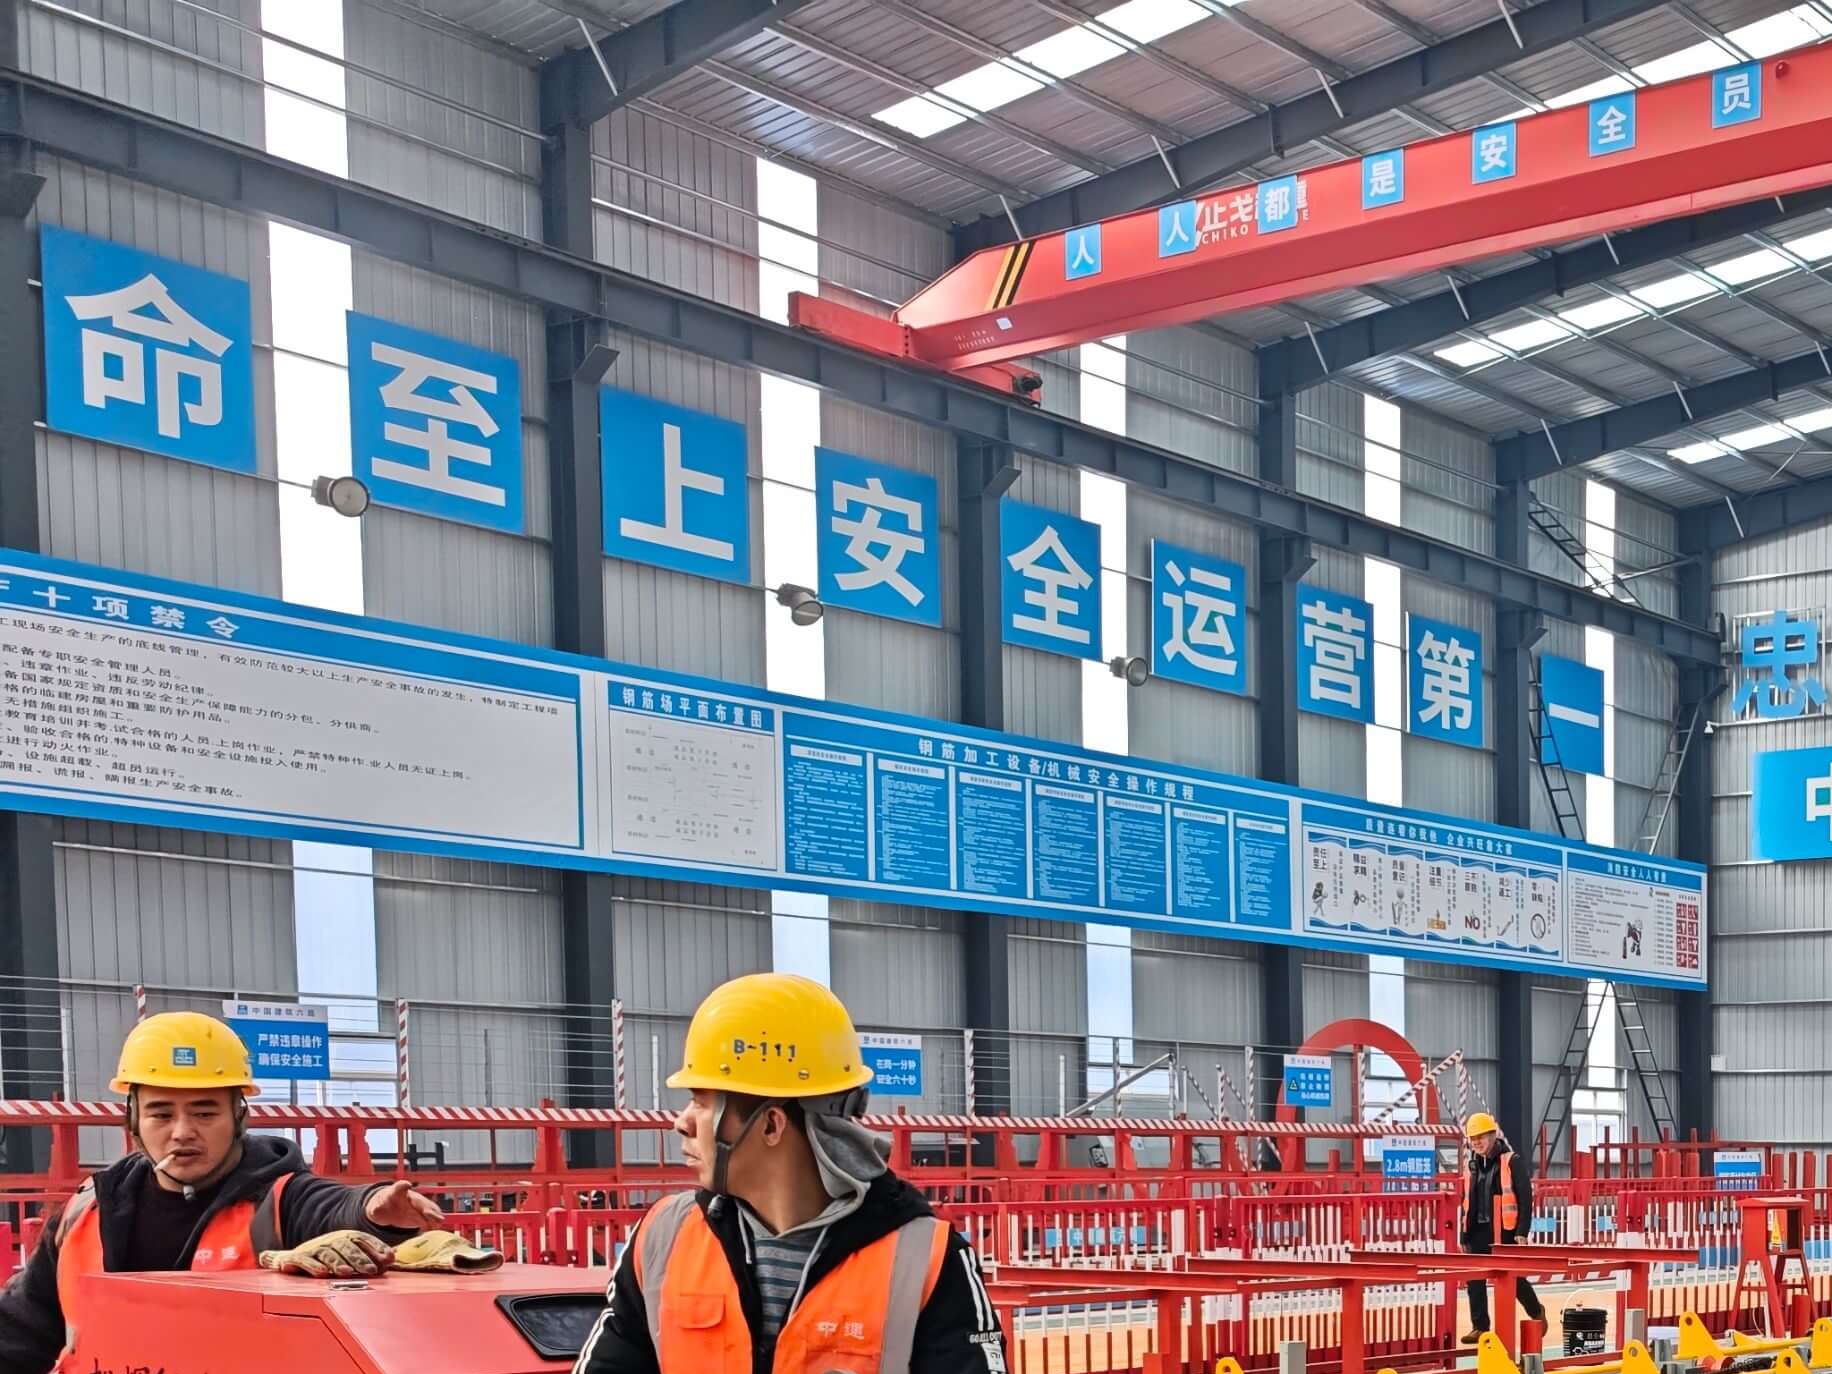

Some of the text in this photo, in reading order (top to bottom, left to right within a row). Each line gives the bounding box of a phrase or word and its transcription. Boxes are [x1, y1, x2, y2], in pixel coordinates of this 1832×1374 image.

[1072, 76, 1751, 269] 人 人 都 是 安 全 员
[1202, 225, 1249, 245] CHIKO
[65, 274, 1601, 731] 命 至 上 安 全 运 营 第 一
[622, 686, 763, 730] 钢筋场平面布置图
[918, 738, 1195, 801] 钢筋加工设备/机械安全操作规程
